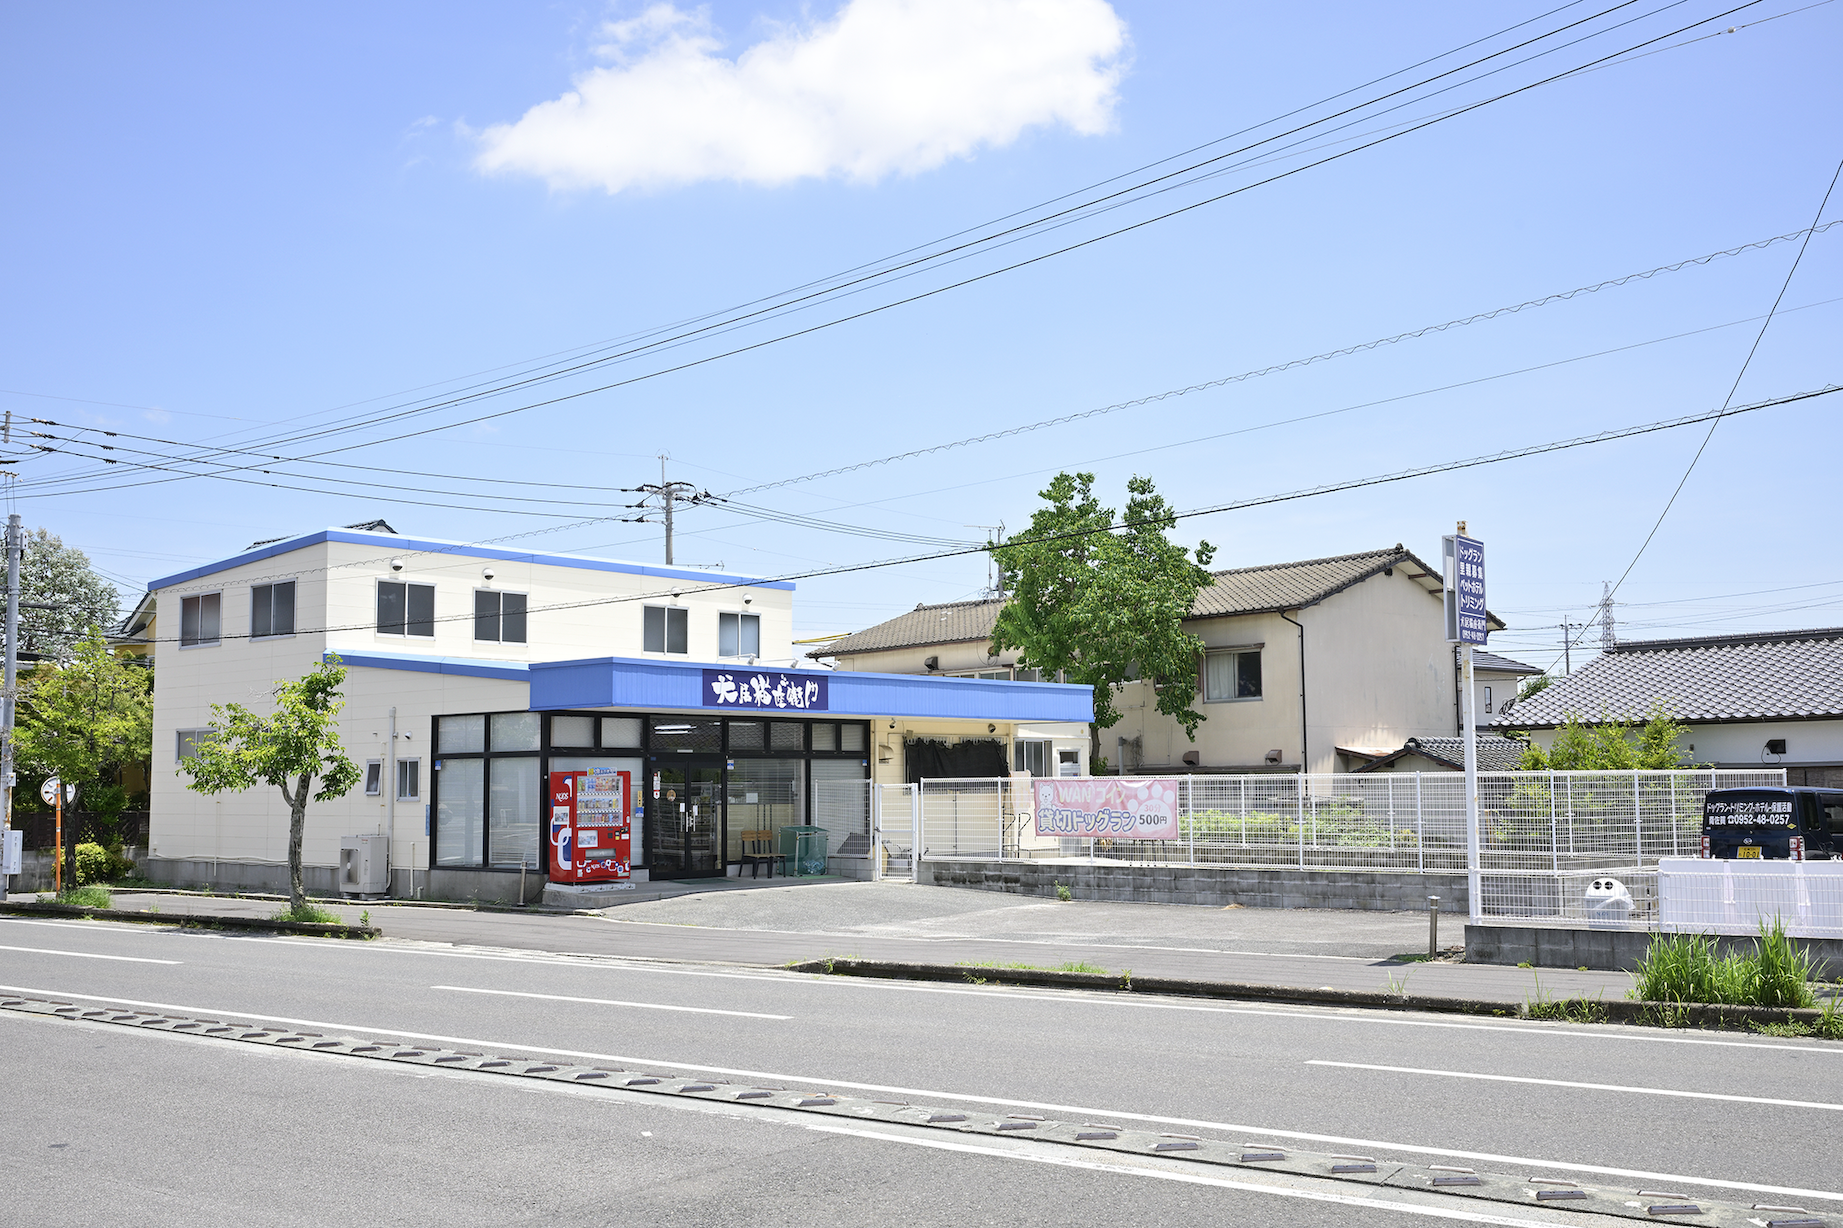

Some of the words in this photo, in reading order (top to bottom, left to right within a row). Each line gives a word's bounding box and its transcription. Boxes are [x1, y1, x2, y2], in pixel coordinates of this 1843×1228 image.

[1460, 546, 1482, 562] ドッグラン
[1460, 562, 1483, 579] 里親募集
[1460, 579, 1484, 596] ペットホテル
[1461, 595, 1483, 611] トリミング
[1058, 786, 1091, 803] WAN
[1095, 787, 1126, 804] コイン
[1143, 804, 1161, 813] 30分
[1037, 808, 1137, 833] 貸切ドッグラン
[1139, 814, 1168, 825] 500円
[1734, 814, 1790, 825] 0952-48-0257
